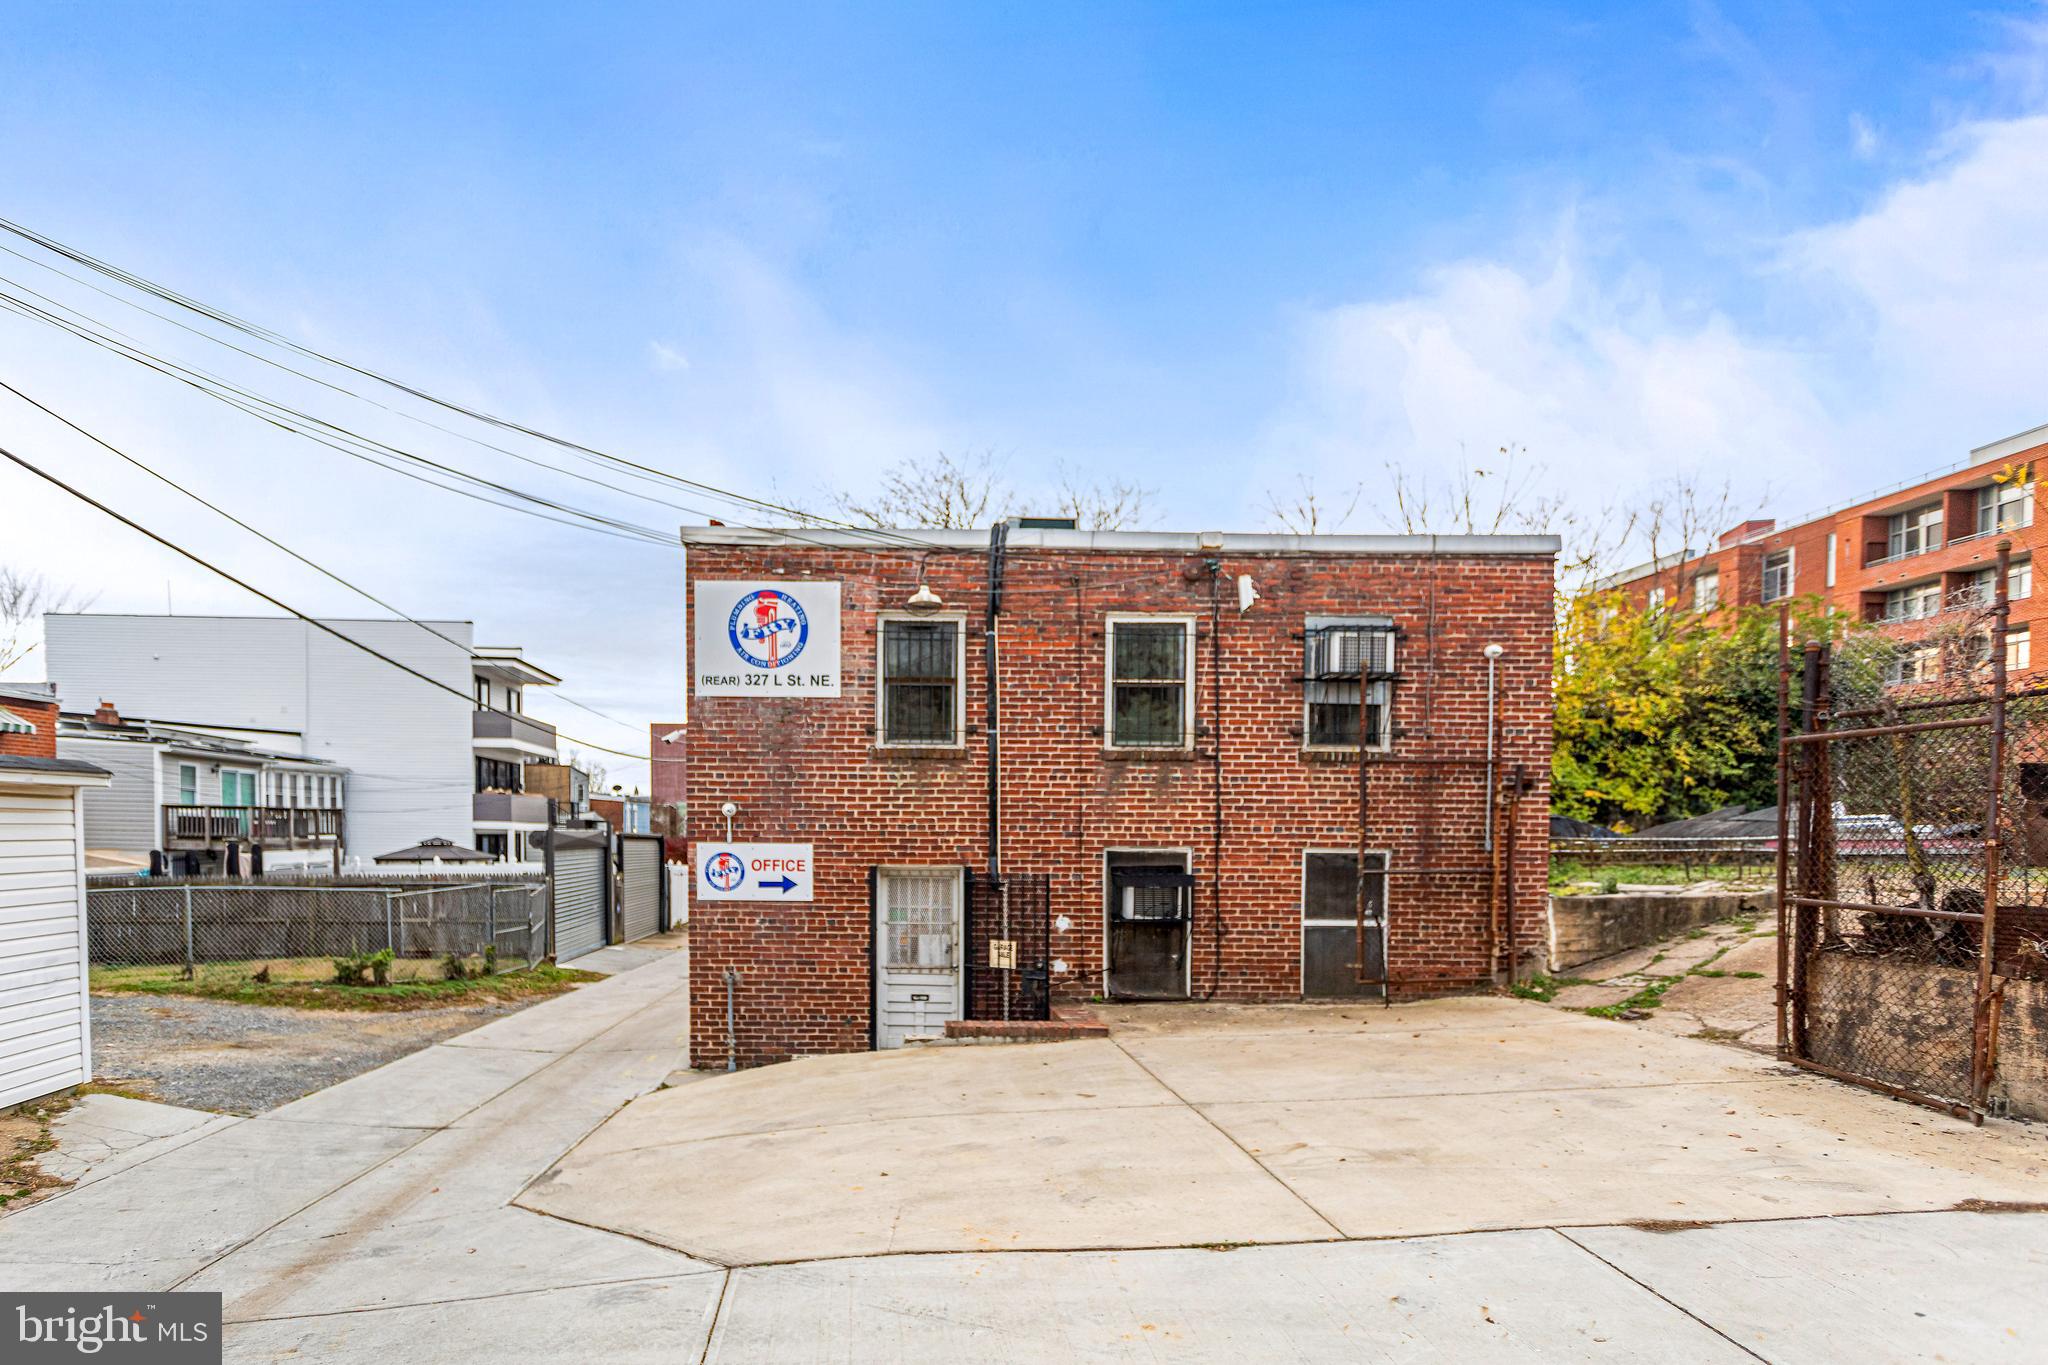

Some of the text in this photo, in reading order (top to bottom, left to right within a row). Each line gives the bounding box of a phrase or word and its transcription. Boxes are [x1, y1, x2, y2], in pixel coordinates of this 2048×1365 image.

[729, 593, 755, 631] PLUMBING
[781, 594, 807, 626] HEATING
[736, 647, 750, 662] AIR
[750, 642, 804, 669] CONDITIONING
[701, 674, 835, 687] (REAR) 327 L St. NE.
[751, 859, 806, 872] OFFICE
